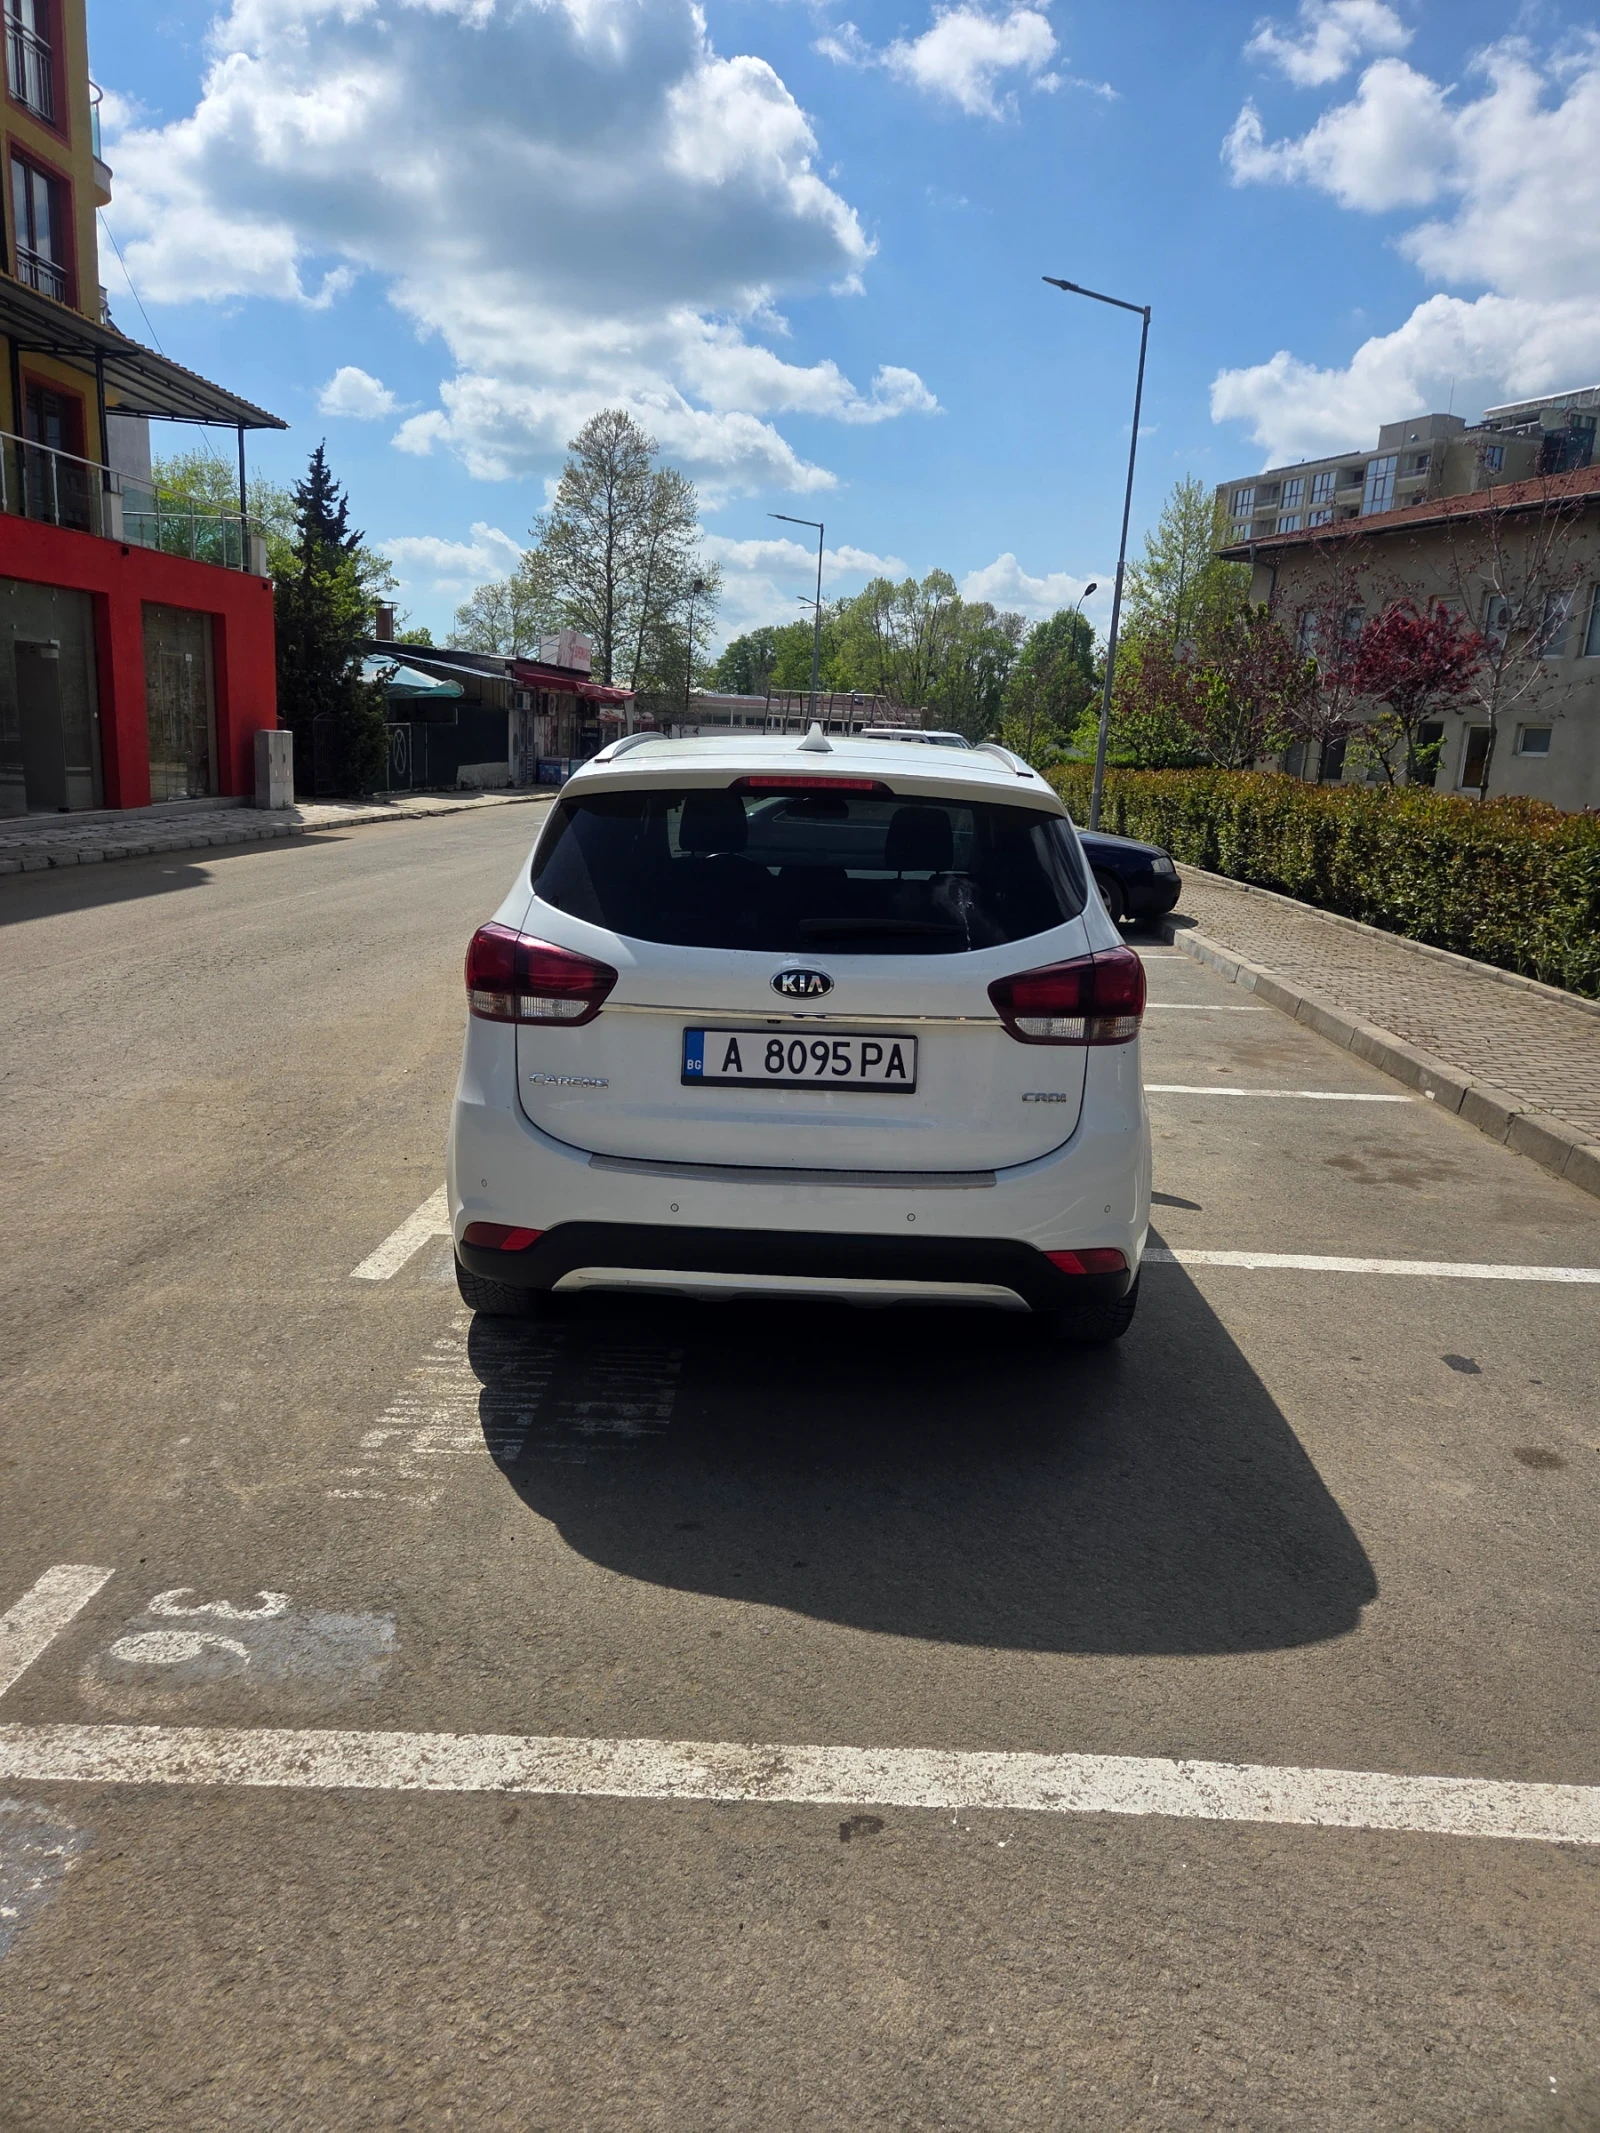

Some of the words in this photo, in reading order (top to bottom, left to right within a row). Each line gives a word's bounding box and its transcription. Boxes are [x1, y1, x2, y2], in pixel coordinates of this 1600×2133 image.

[781, 974, 824, 993] KIA
[687, 1059, 702, 1070] BG
[721, 1037, 743, 1073] A
